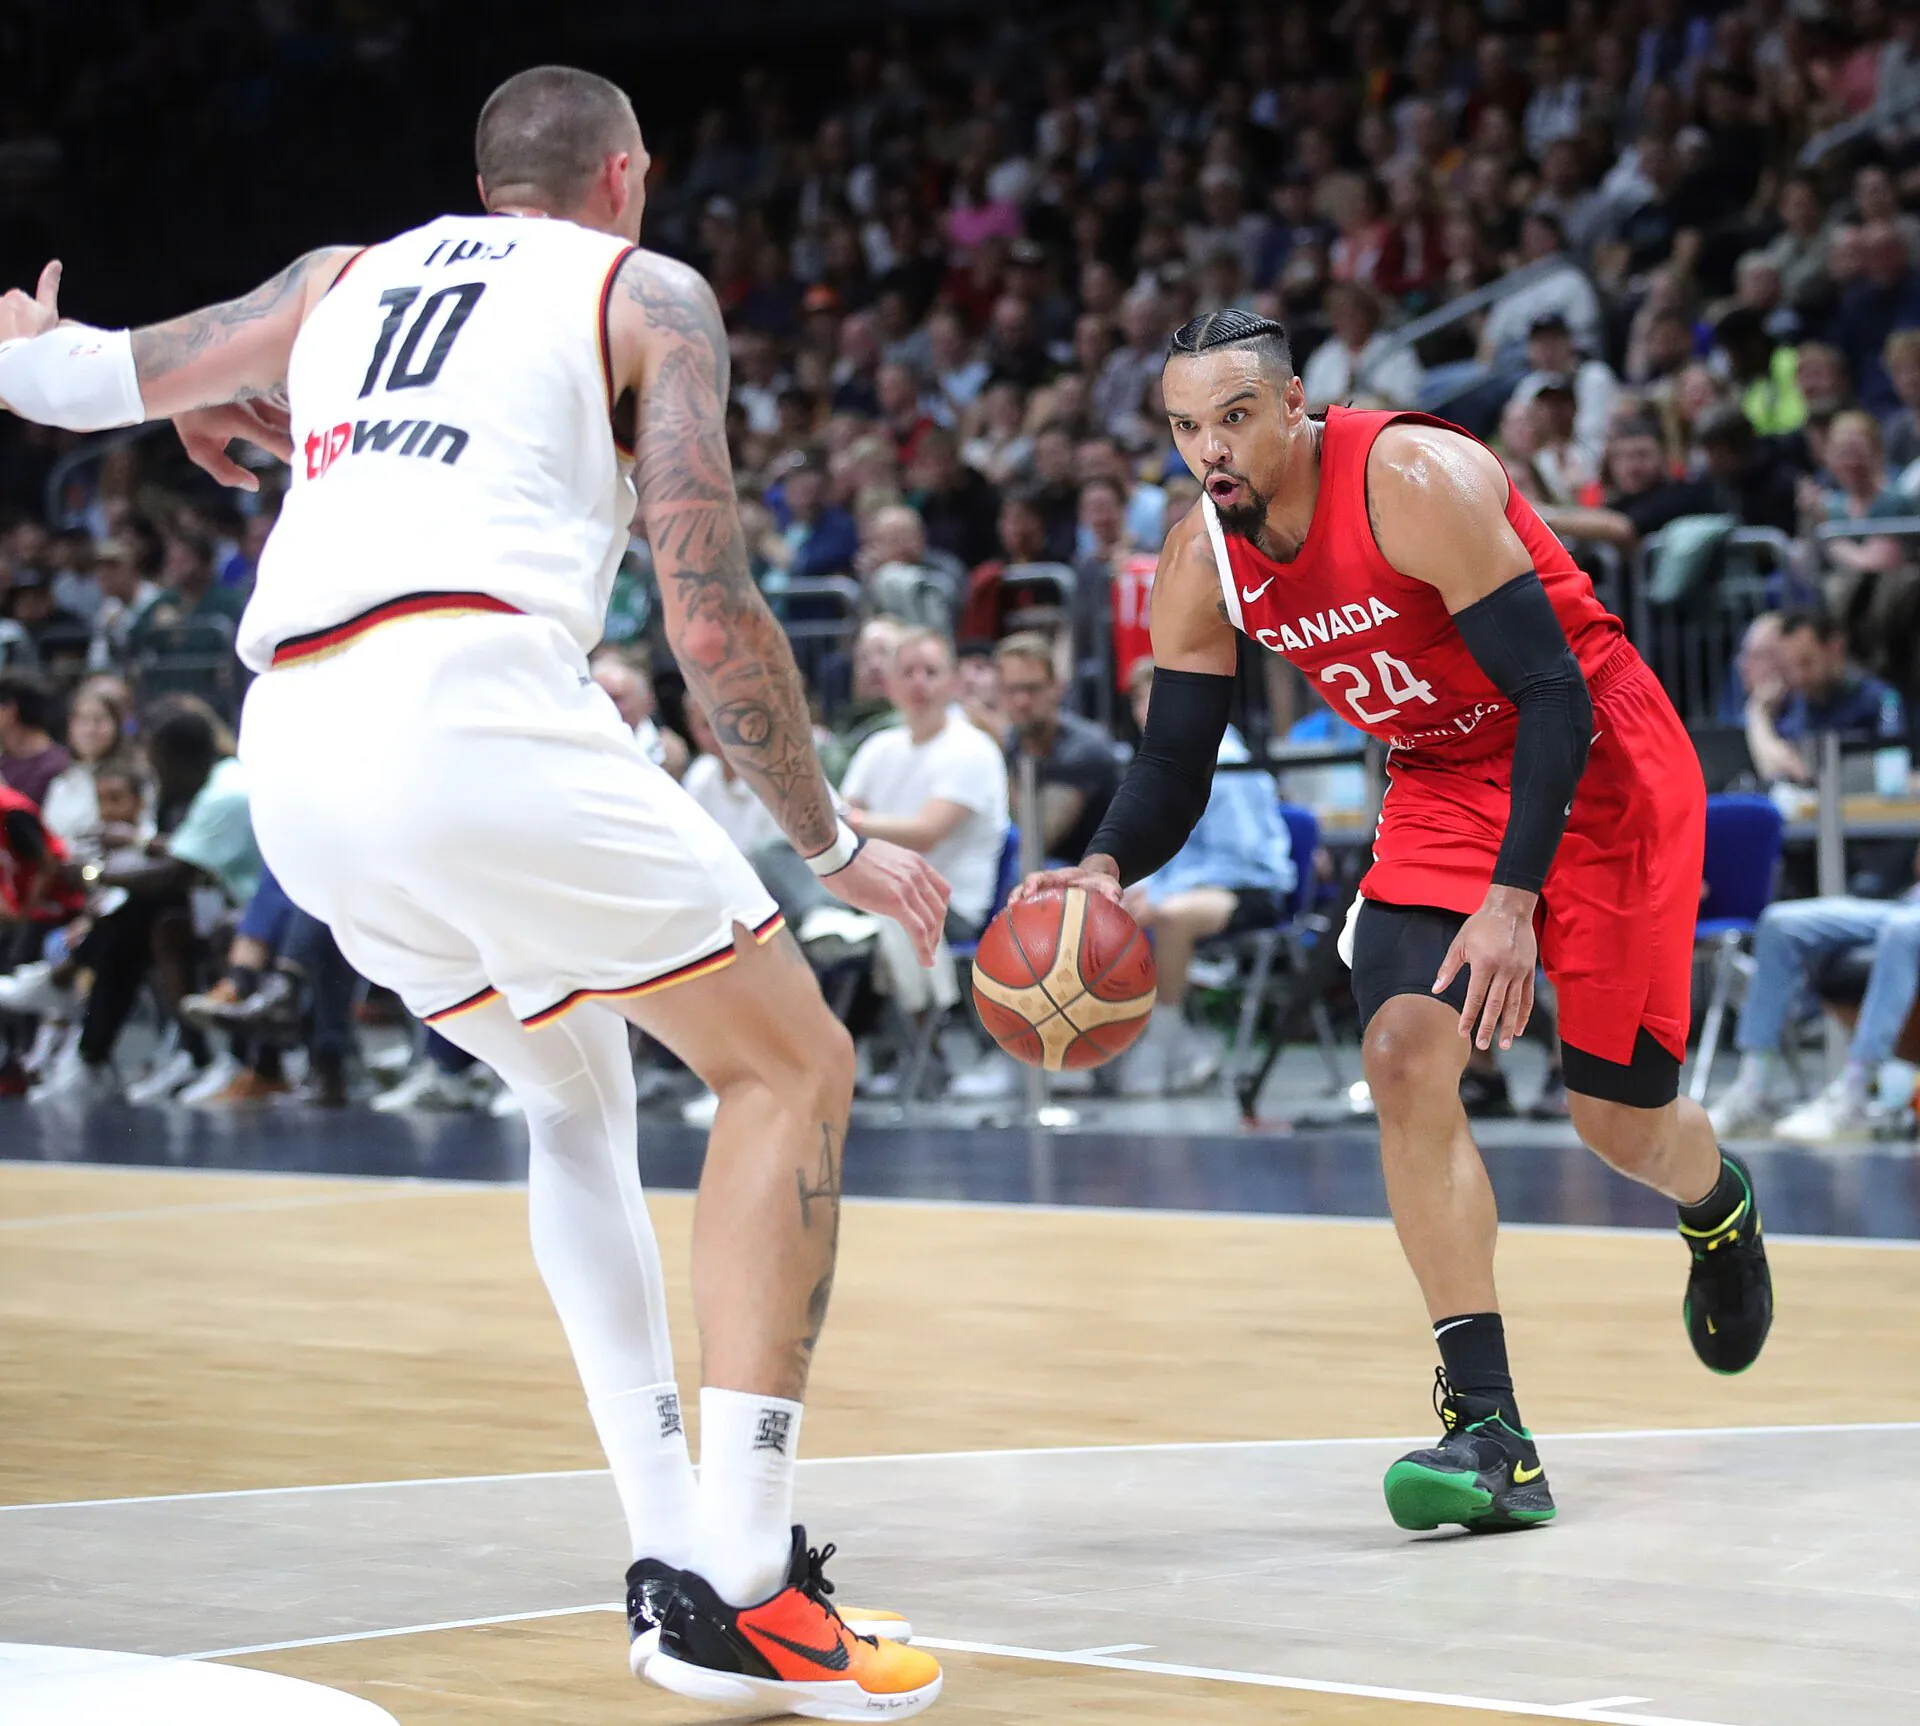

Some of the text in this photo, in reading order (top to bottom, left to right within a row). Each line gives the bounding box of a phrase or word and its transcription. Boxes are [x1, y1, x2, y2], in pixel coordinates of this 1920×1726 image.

[356, 281, 487, 400] 10
[1255, 596, 1400, 652] CANADA
[1320, 650, 1439, 725] 24
